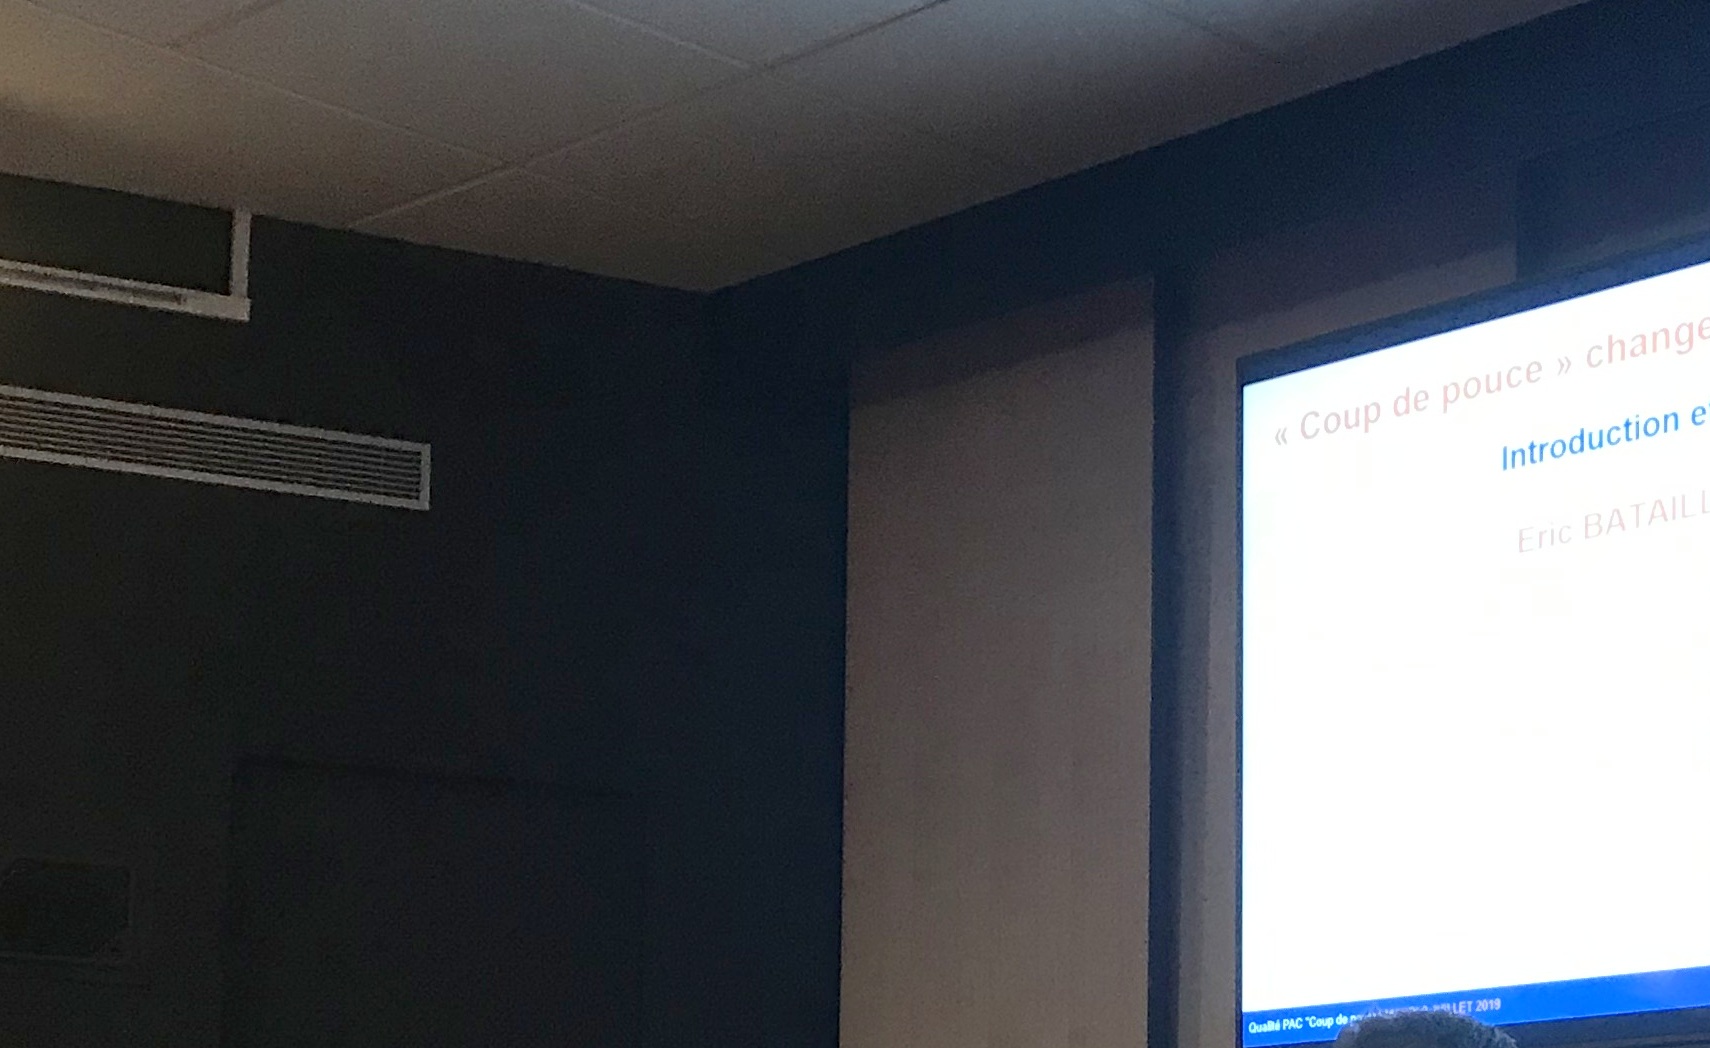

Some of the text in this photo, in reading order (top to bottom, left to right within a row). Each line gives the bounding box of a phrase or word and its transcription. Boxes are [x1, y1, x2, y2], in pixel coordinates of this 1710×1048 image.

[1300, 401, 1382, 442] Coup
[1392, 386, 1430, 418] de
[1443, 358, 1544, 407] pouce
[1502, 411, 1680, 470] Introduction
[1518, 520, 1572, 554] Eric
[1282, 1016, 1303, 1031] PAC
[1336, 1012, 1348, 1026] de
